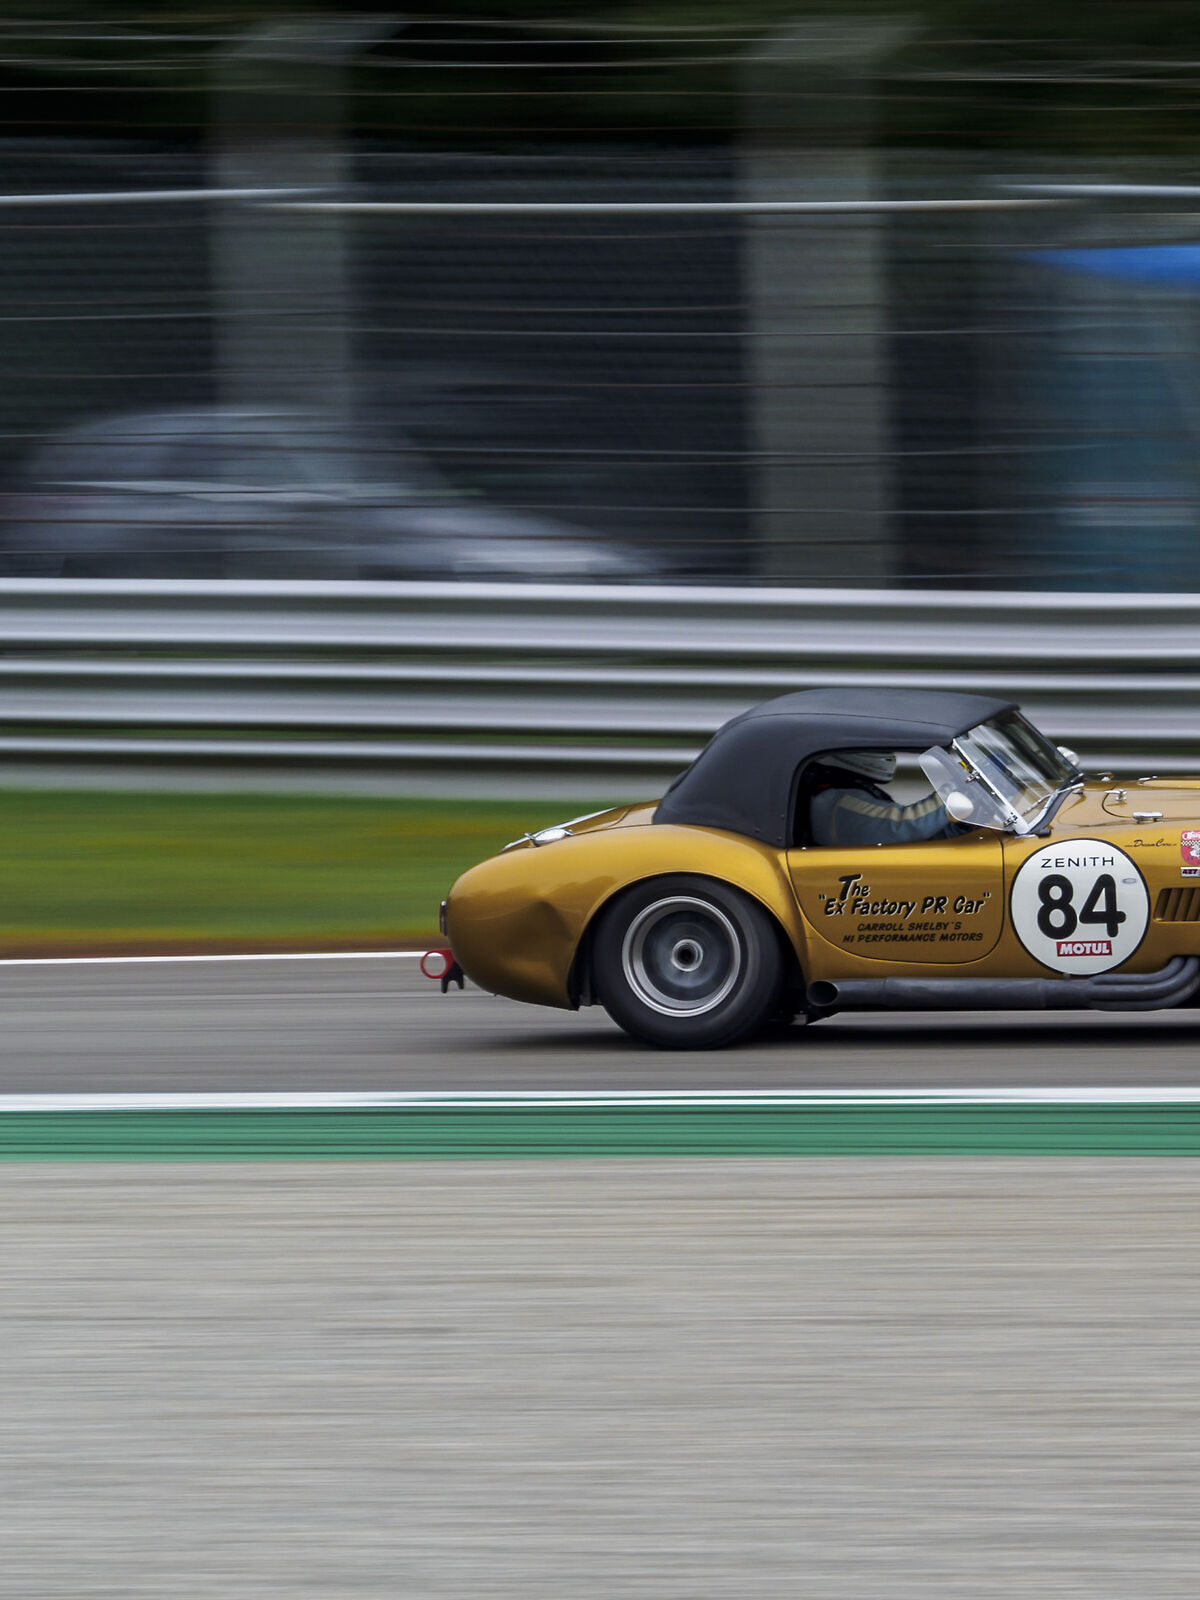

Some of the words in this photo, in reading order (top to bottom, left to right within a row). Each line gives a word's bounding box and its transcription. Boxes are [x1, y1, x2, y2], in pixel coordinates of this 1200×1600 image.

[1041, 856, 1114, 868] ZENITH
[838, 873, 871, 901] The
[851, 897, 917, 920] Factory
[920, 896, 949, 915] PR
[1037, 873, 1127, 940] 84
[857, 923, 904, 932] CARROLL
[842, 935, 855, 943] HI
[857, 933, 936, 943] PERFORMANCE
[939, 932, 984, 942] MOTORS
[1059, 942, 1110, 955] MOTUL
